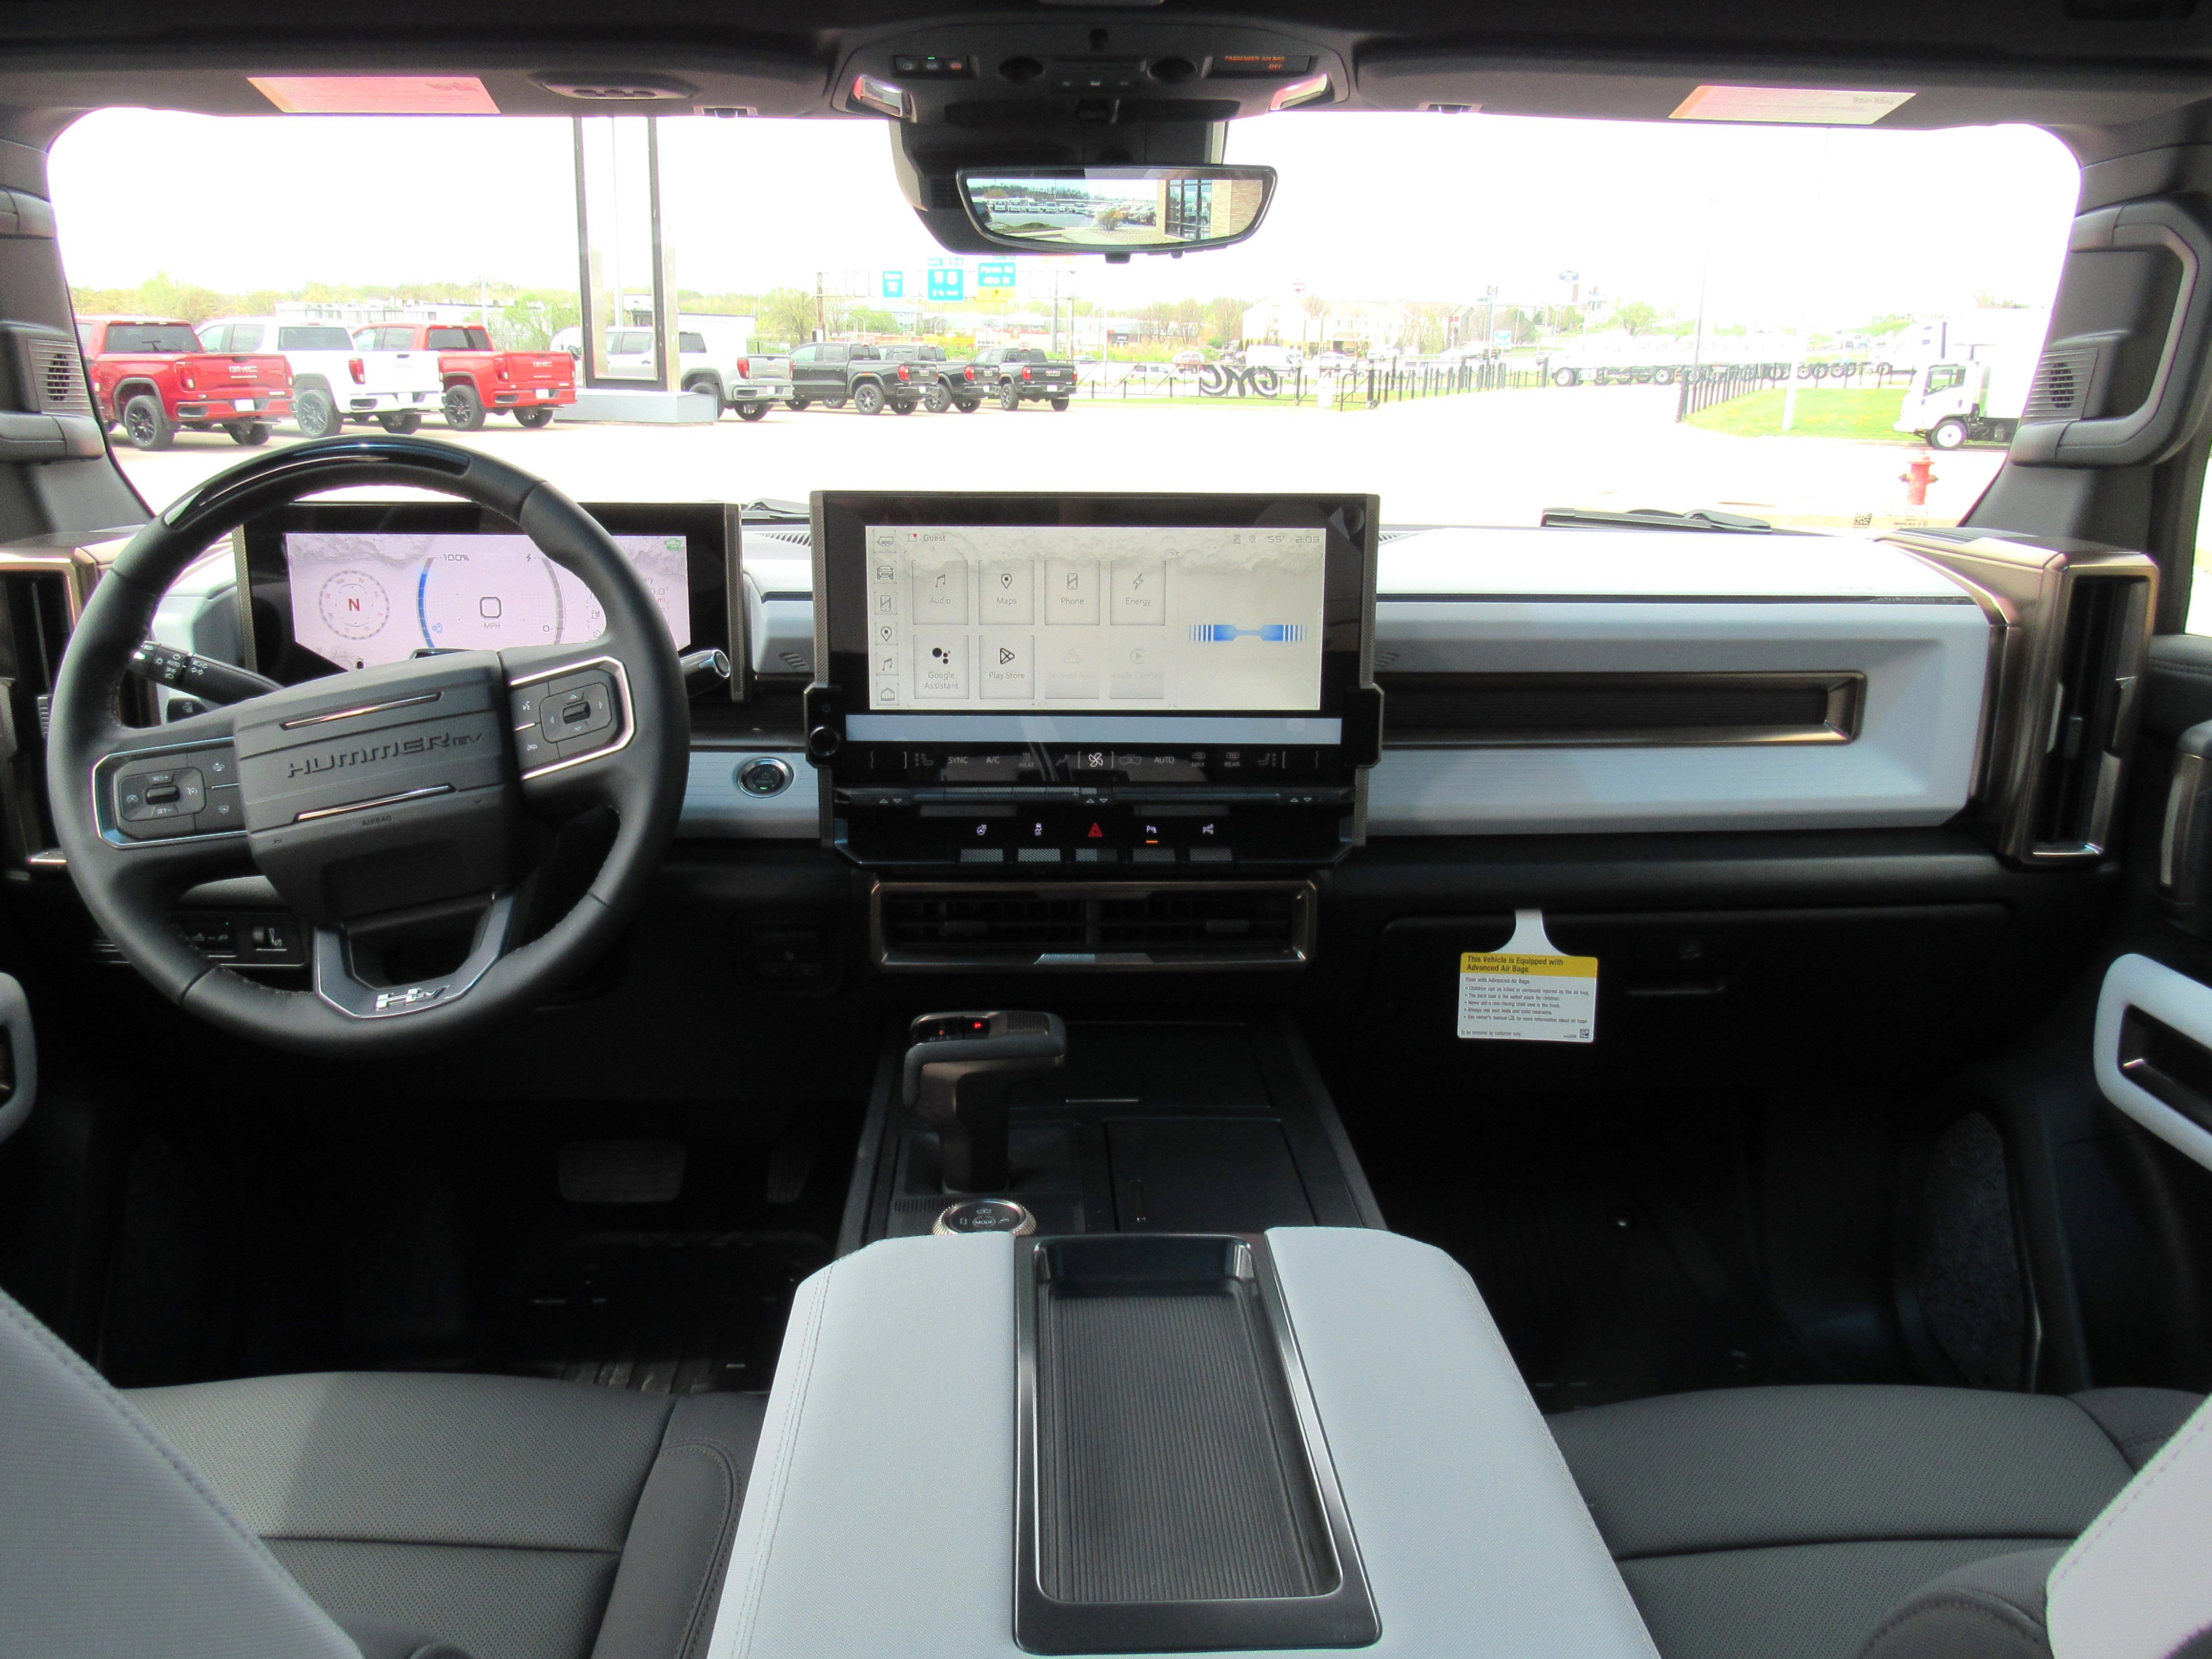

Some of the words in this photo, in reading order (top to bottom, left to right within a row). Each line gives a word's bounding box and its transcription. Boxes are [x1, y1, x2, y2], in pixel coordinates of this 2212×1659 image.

[348, 598, 361, 612] N
[997, 597, 1017, 606] Maps
[1125, 597, 1151, 606] Energy
[928, 672, 955, 680] Google
[989, 672, 1004, 680] Play
[288, 733, 450, 778] HUMMER
[453, 733, 483, 746] EV
[362, 816, 393, 826] AIRBAG
[1516, 957, 1547, 966] Equipped
